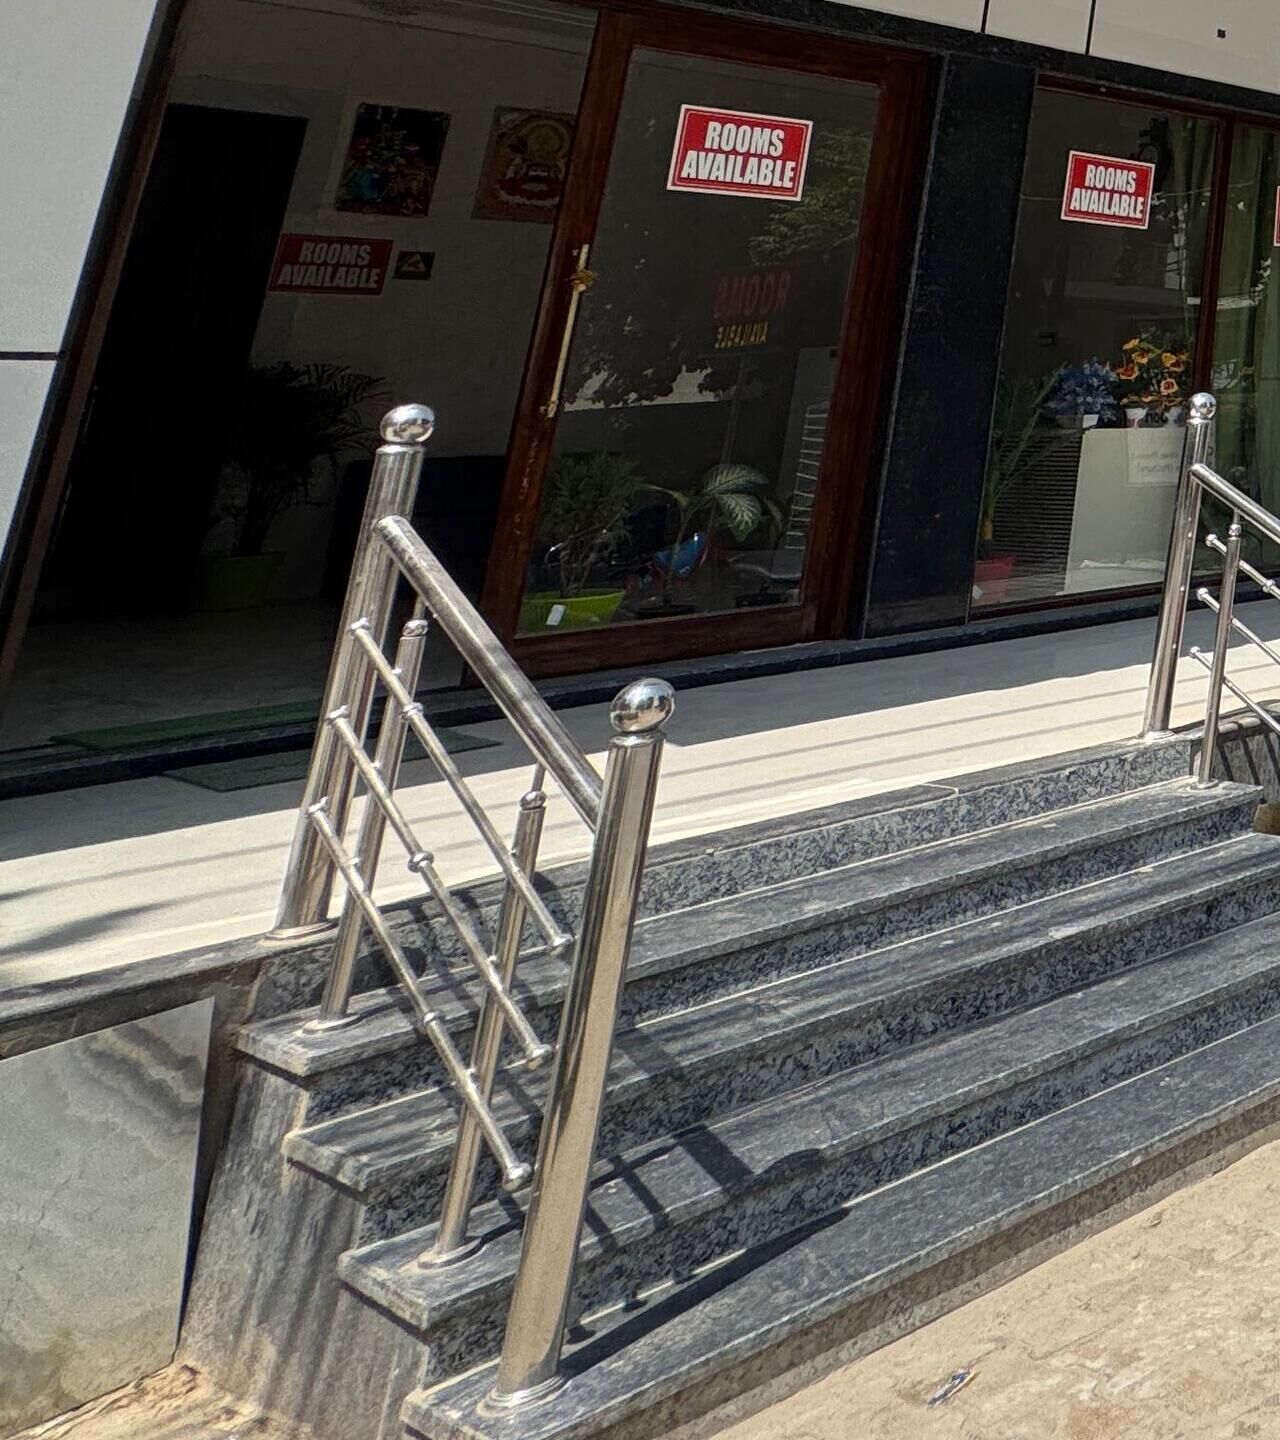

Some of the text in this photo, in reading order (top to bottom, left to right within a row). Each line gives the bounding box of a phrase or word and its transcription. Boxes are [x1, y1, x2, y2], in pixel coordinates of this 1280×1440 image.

[704, 120, 785, 158] ROOMS
[680, 150, 797, 189] AVAILABLE
[1084, 164, 1137, 194] ROOMS
[1069, 187, 1145, 219] AVAILABLE
[299, 241, 372, 266] ROOMS
[277, 263, 381, 289] AVAILABLE
